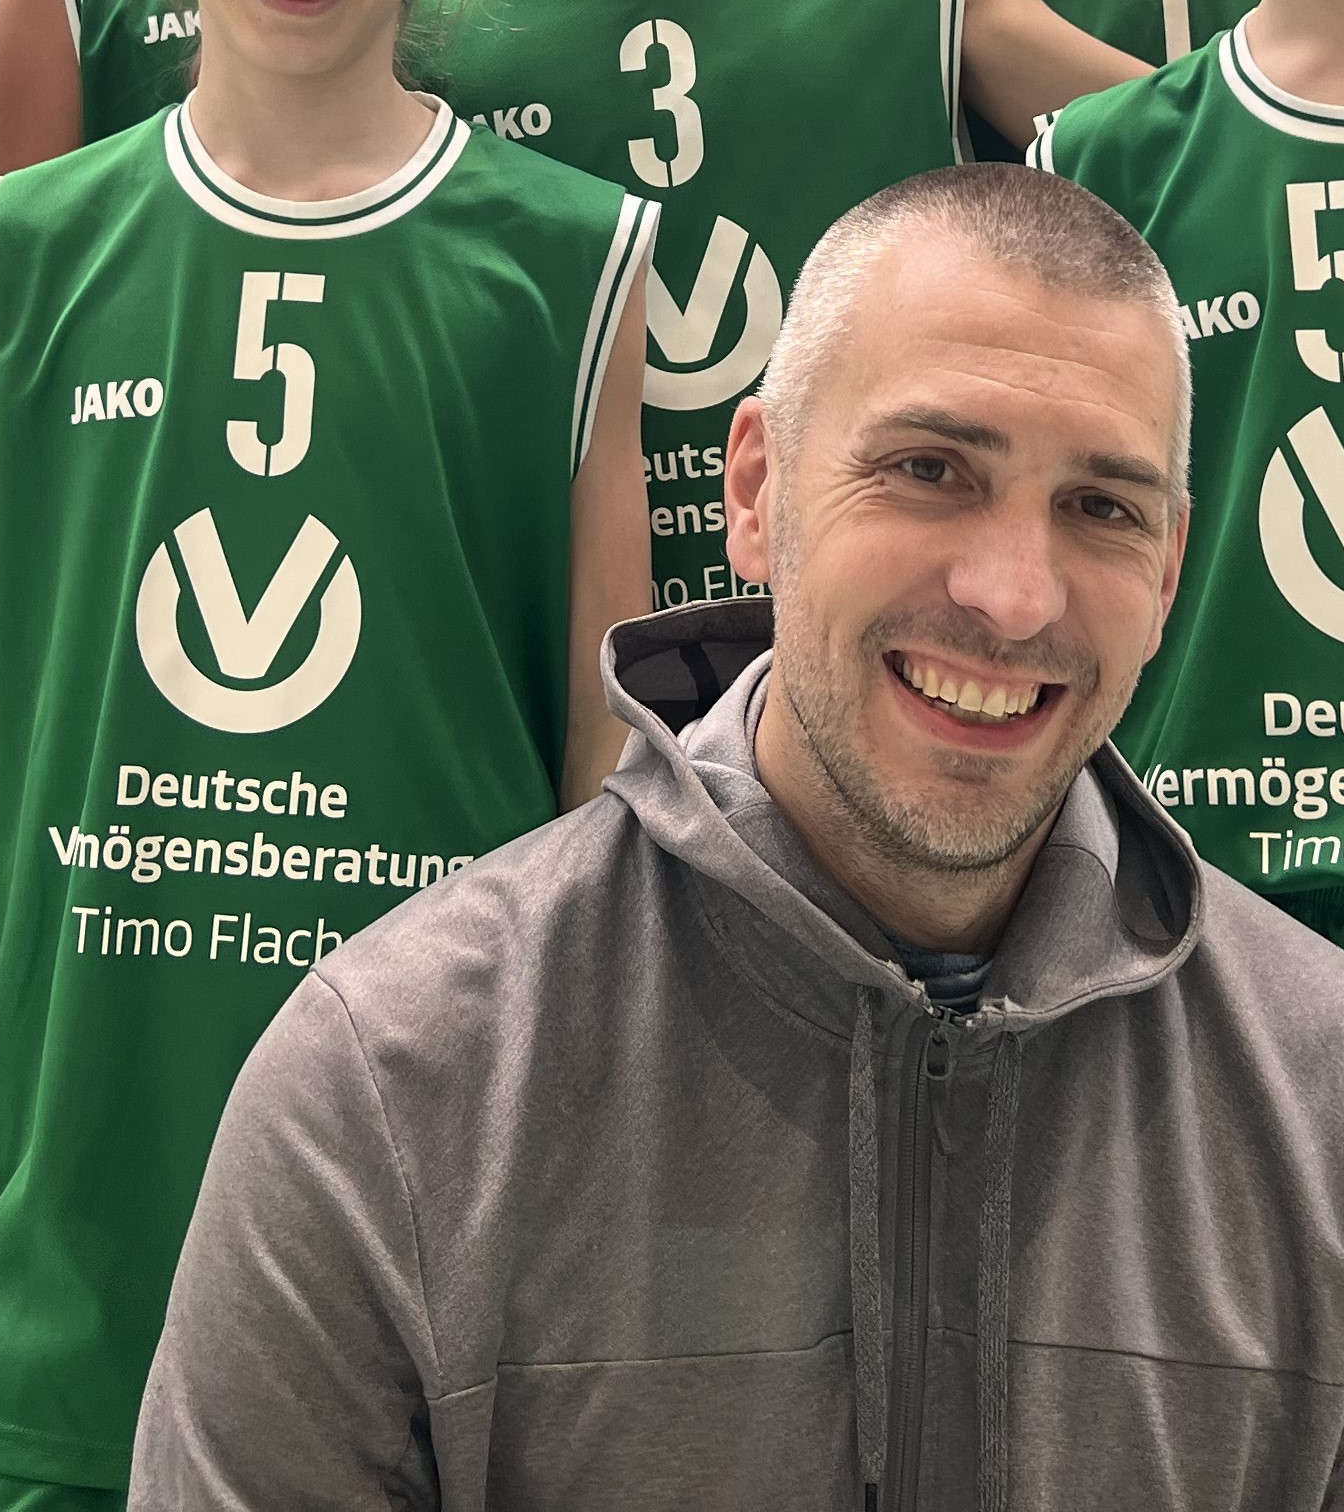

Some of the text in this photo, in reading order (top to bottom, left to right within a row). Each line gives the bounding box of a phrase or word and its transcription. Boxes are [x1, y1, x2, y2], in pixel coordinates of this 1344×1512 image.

[619, 19, 705, 189] 3
[70, 377, 164, 425] JAKO
[226, 271, 326, 477] 5
[116, 764, 349, 819] Deutsche
[71, 905, 193, 958] Timo
